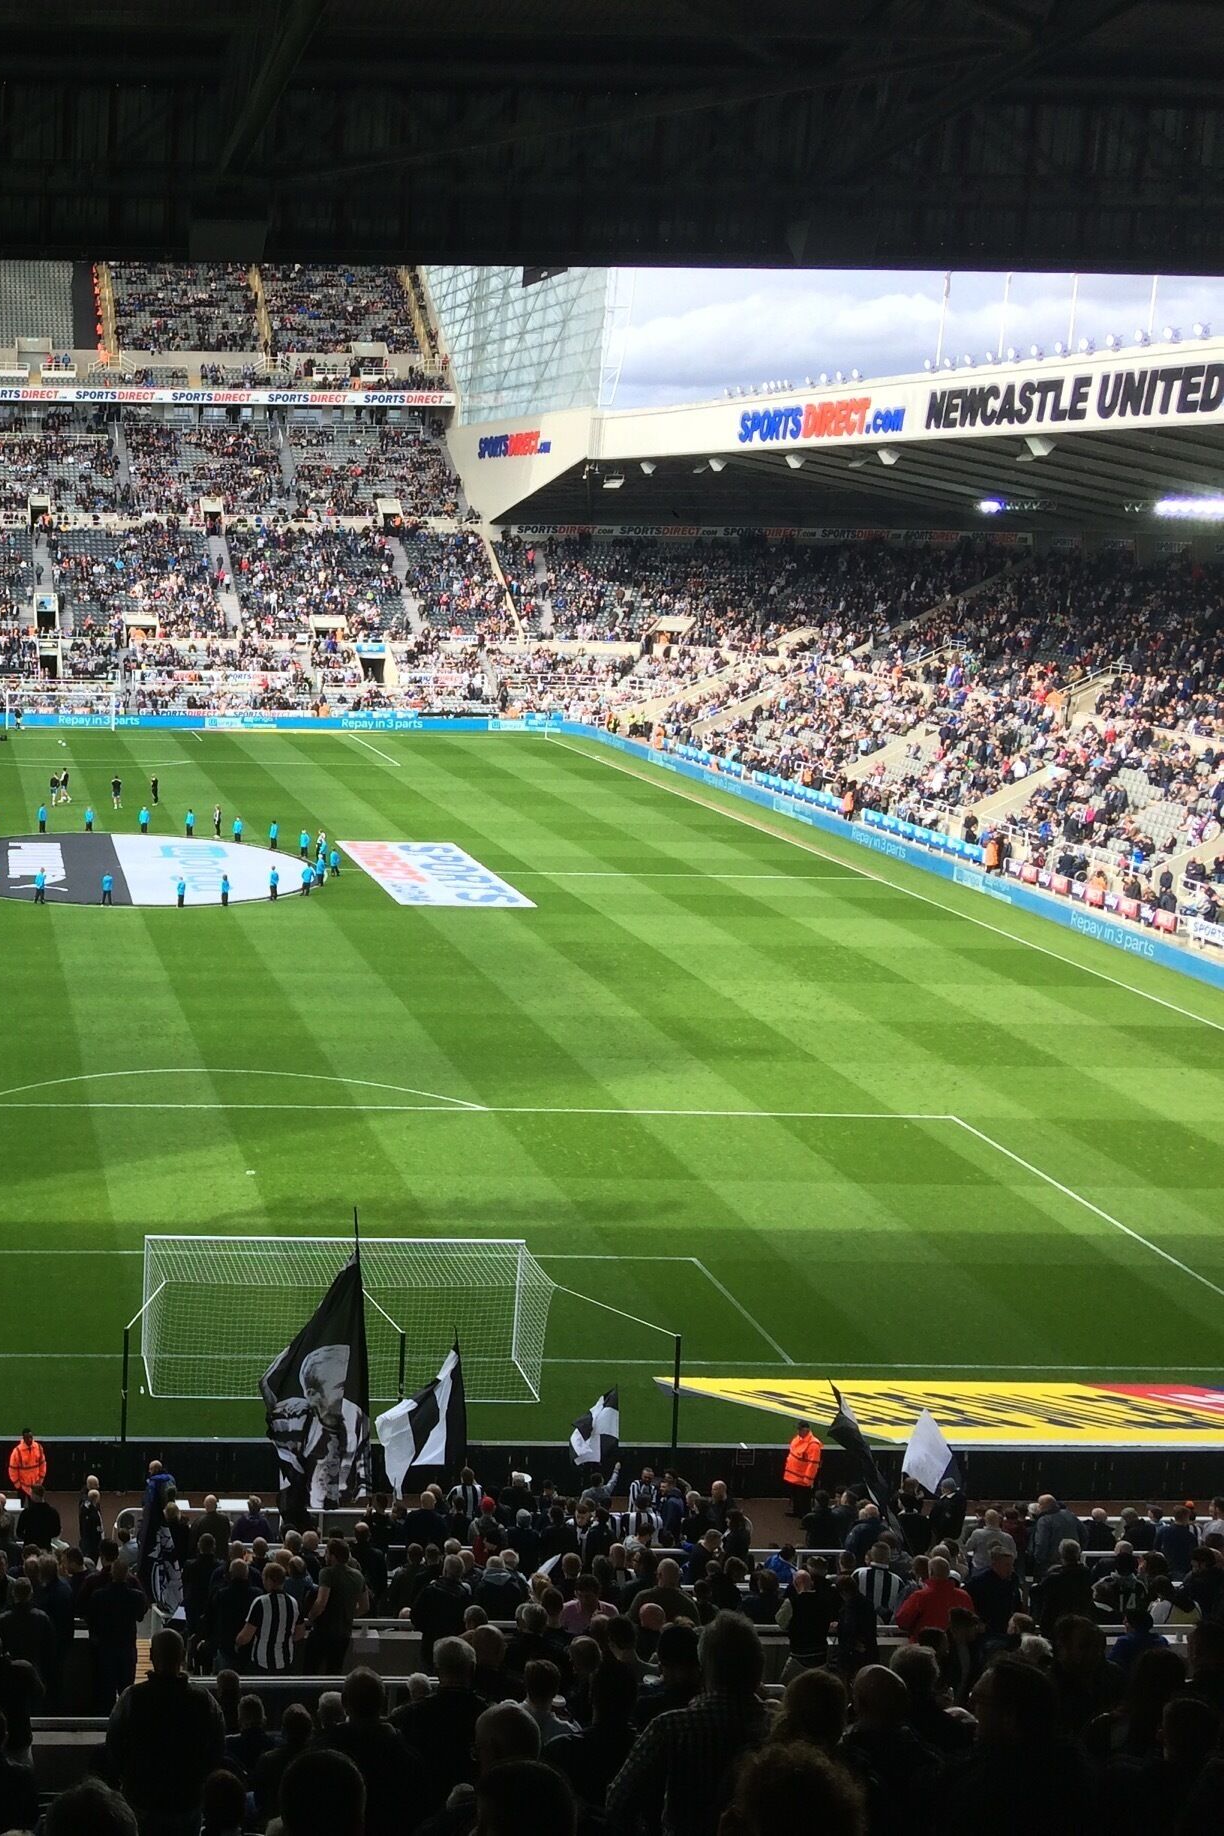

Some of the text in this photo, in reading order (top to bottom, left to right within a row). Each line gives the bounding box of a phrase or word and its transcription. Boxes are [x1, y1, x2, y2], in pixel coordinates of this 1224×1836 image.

[925, 363, 1224, 430] NEWCASTLE UNITED
[59, 715, 140, 726] Repay in 3 parts
[342, 719, 423, 730] Repay in 3 parts
[852, 826, 872, 849] Repay
[887, 841, 907, 859] parts
[1071, 911, 1155, 957] Repay in 3 parts
